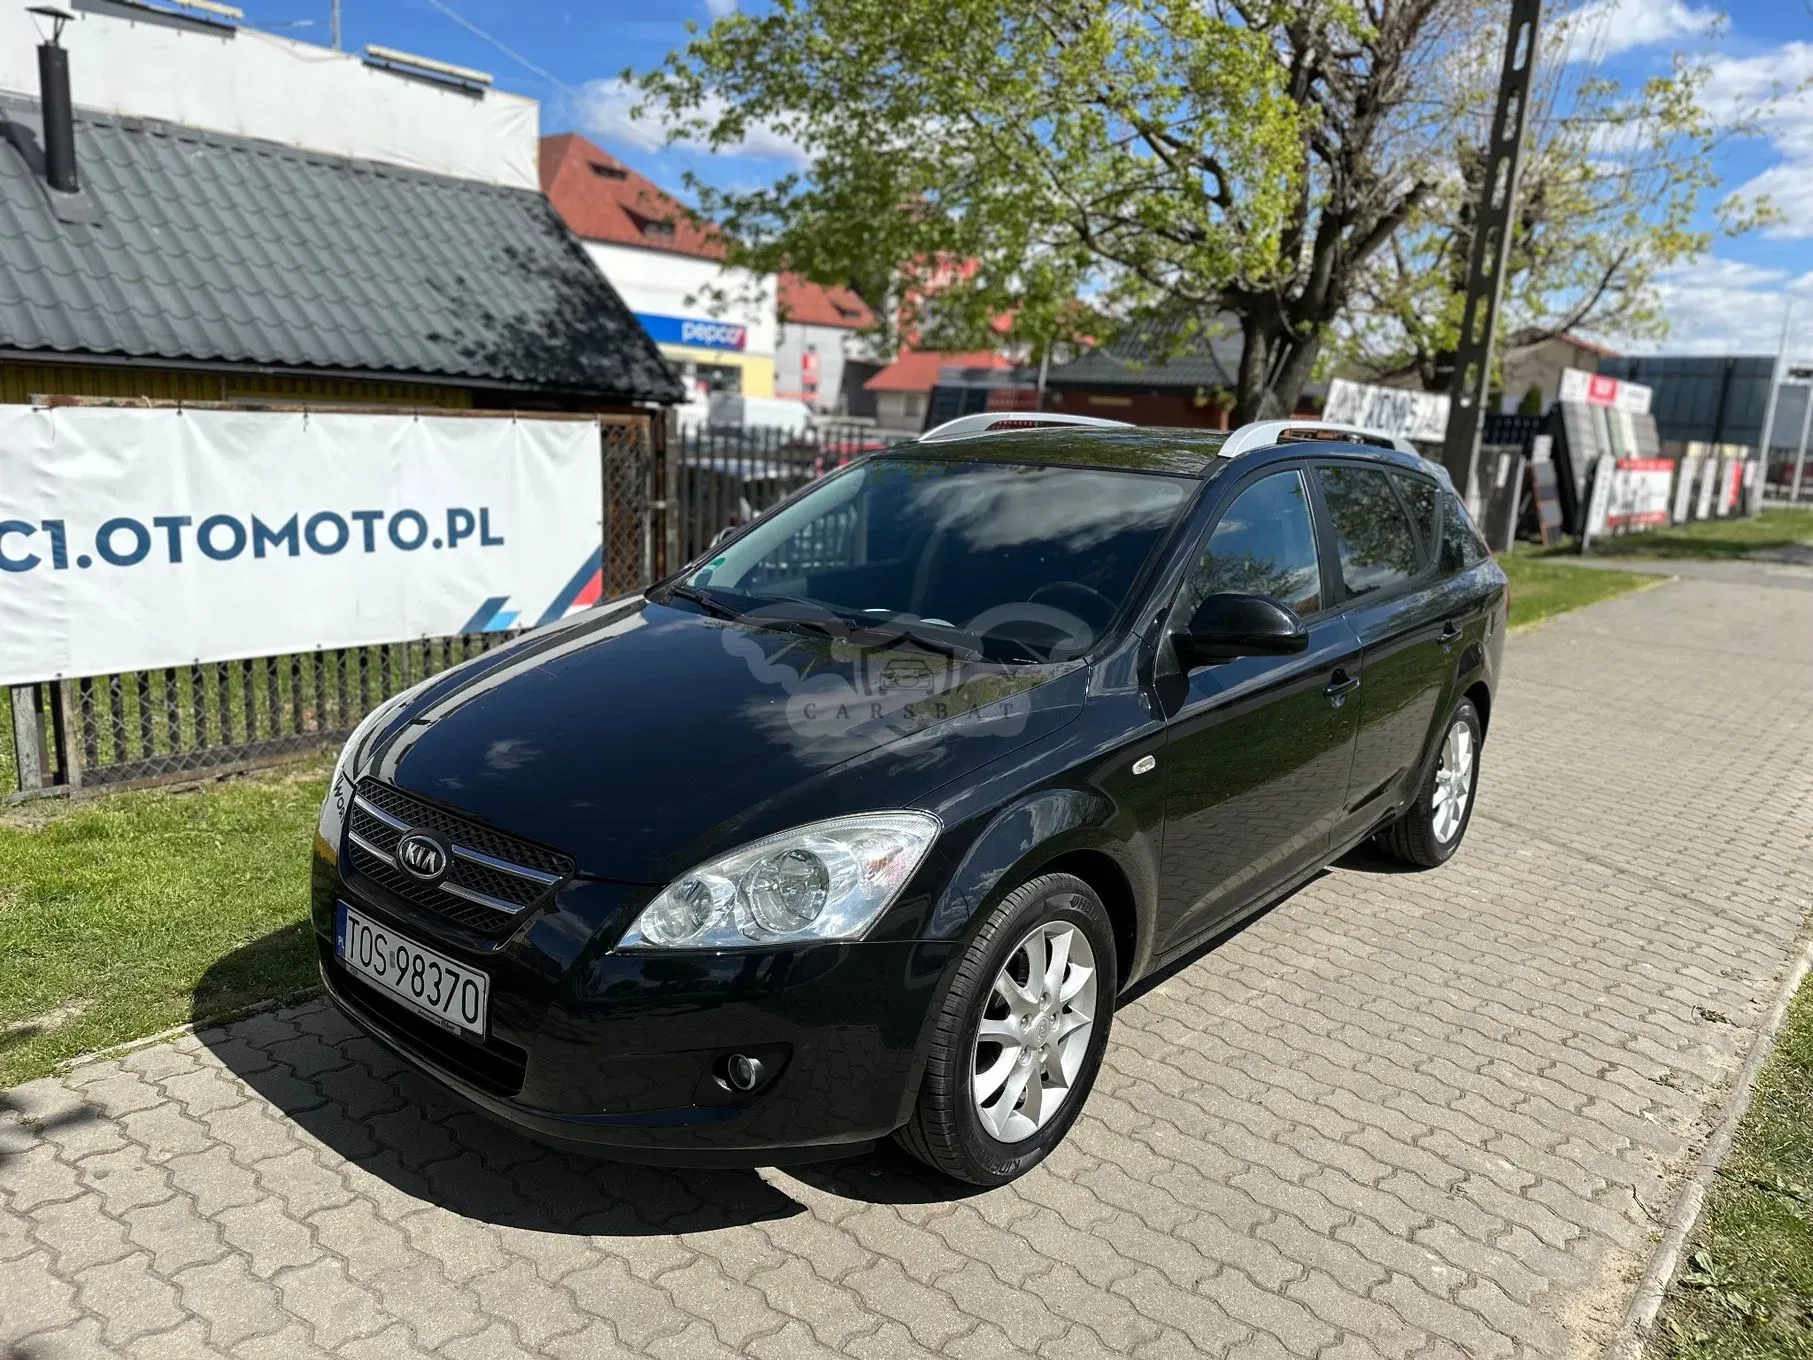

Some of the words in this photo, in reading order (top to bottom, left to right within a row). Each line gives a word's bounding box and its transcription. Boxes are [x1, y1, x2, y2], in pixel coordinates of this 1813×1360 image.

[682, 321, 741, 345] pepco
[0, 507, 505, 573] C1.OTOMOTO.PL
[405, 841, 437, 873] KIA
[348, 915, 388, 977] TOS
[396, 945, 480, 1025] 98370
